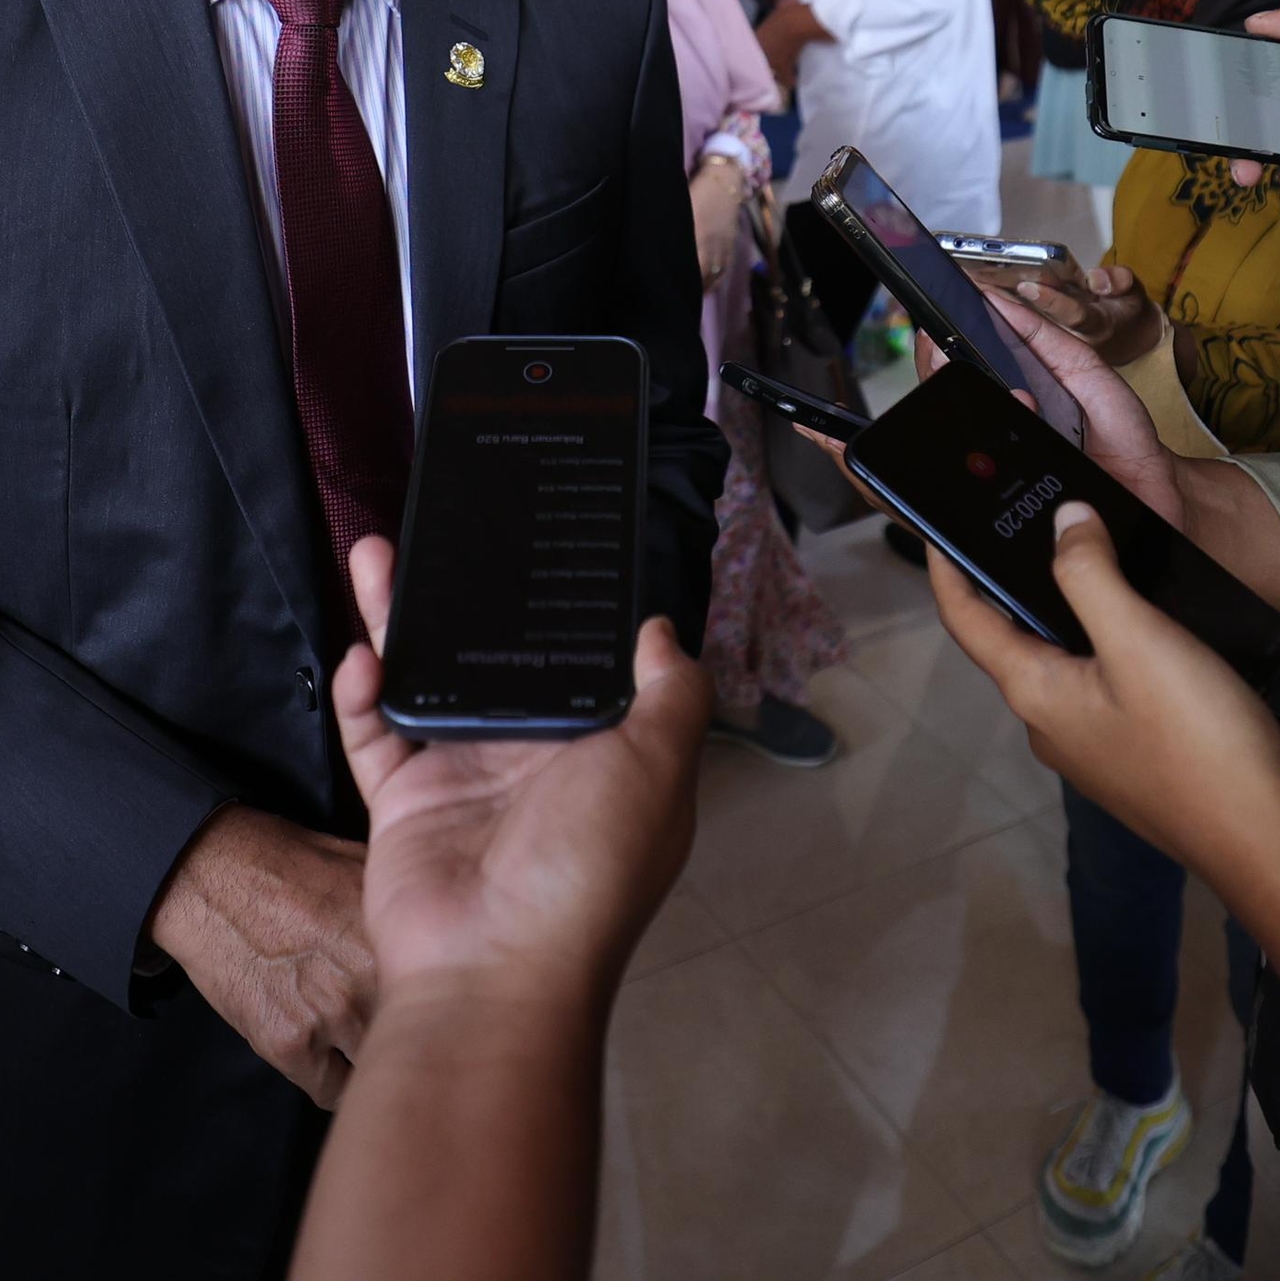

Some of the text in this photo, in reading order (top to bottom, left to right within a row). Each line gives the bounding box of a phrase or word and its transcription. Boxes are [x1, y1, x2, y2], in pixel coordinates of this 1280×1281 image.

[531, 434, 584, 444] Rekaman
[995, 475, 1063, 538] 00:00:20
[457, 651, 545, 669] Rekaman
